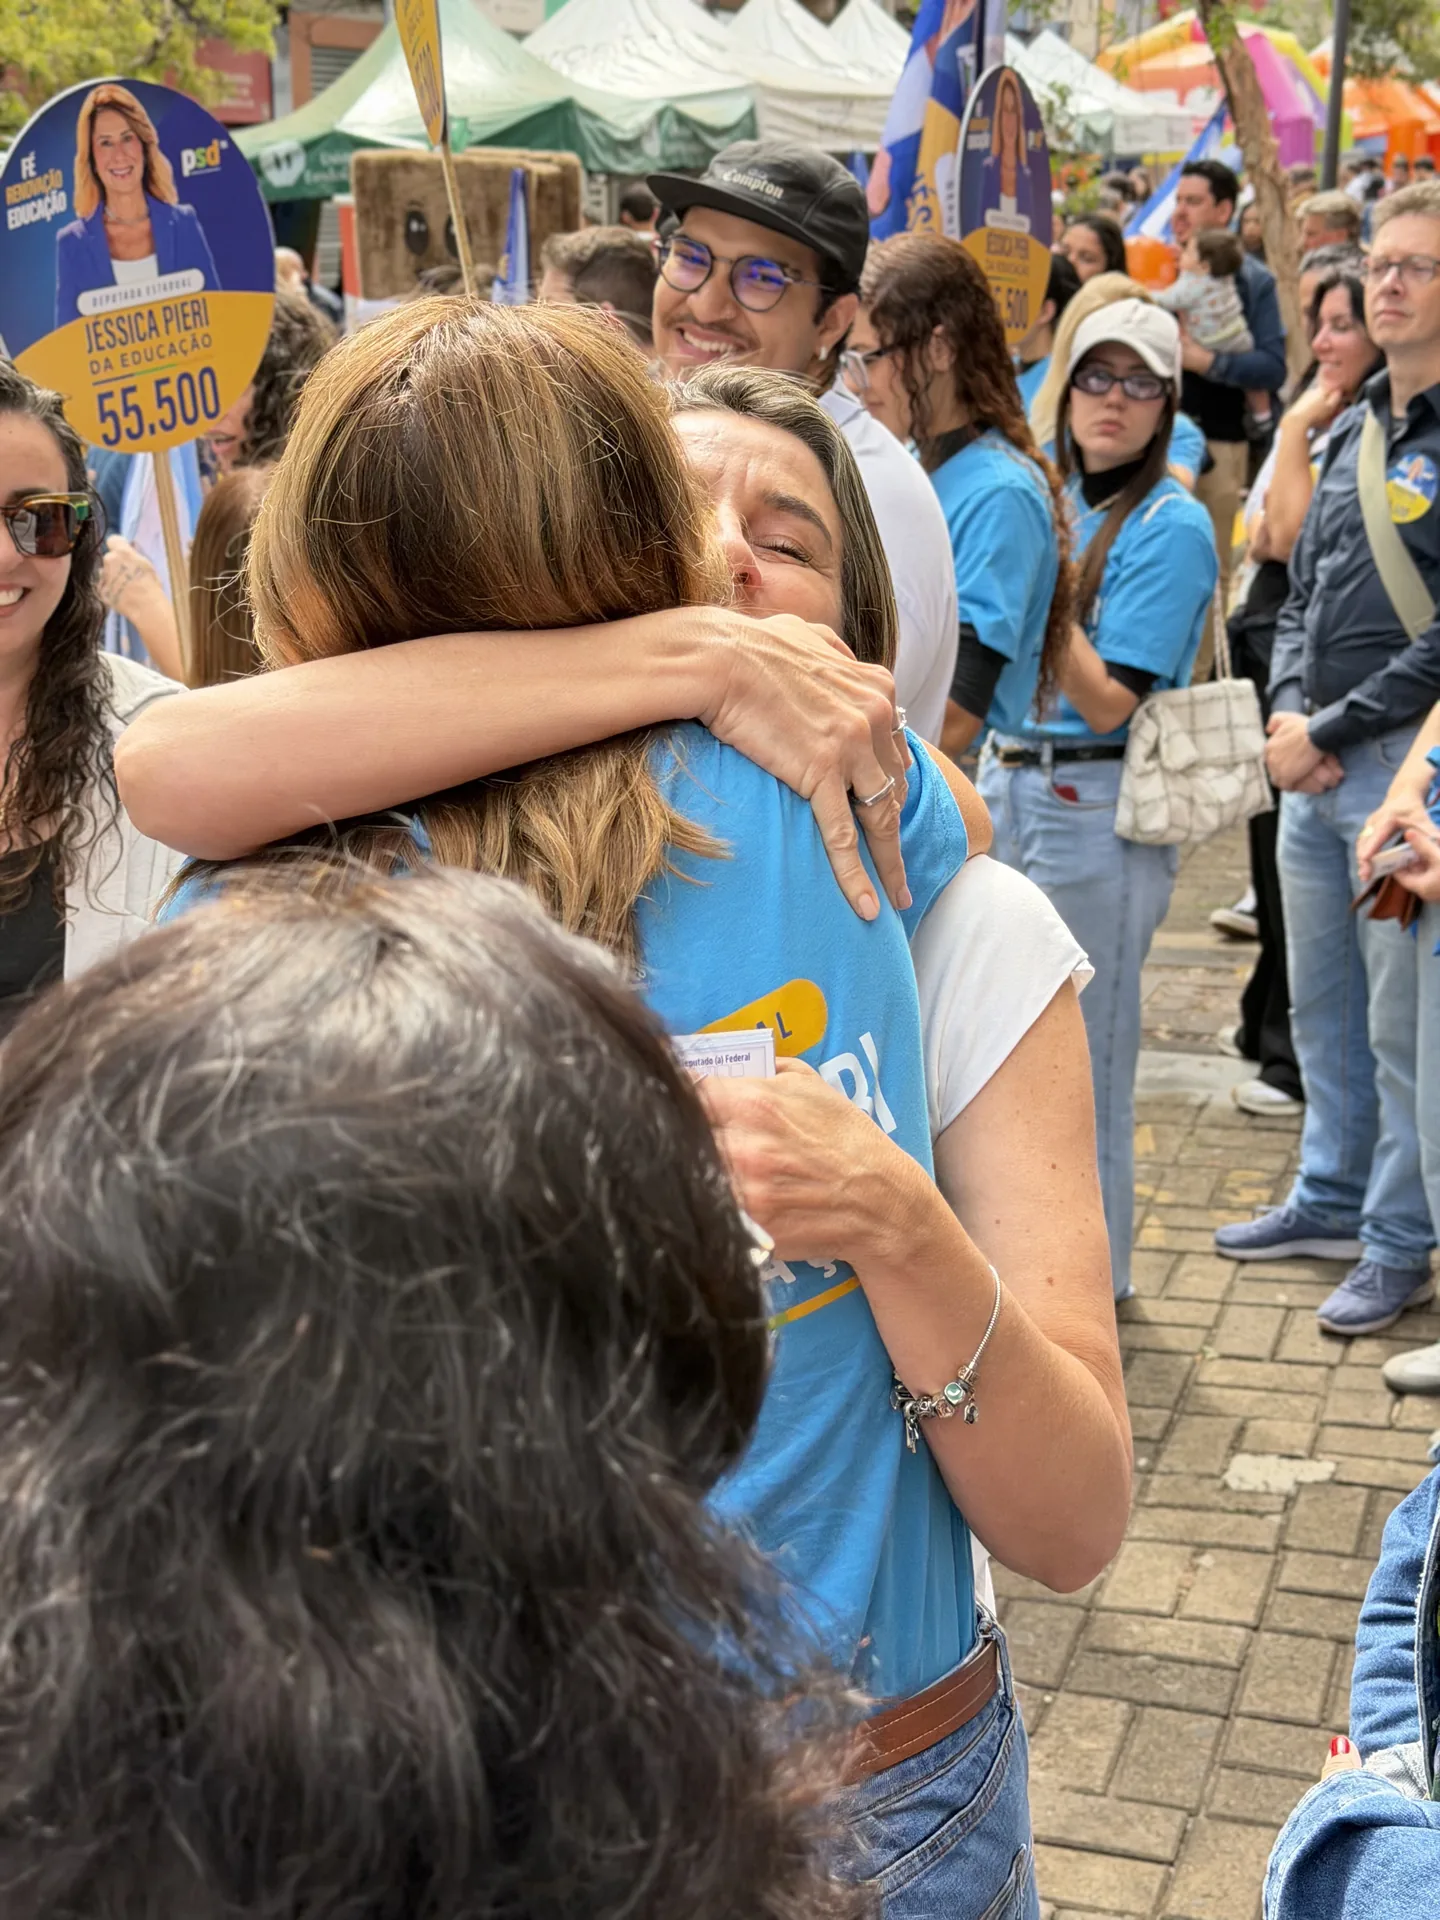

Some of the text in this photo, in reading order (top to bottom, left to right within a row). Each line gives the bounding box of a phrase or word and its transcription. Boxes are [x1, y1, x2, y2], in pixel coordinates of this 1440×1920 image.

[20, 151, 36, 179] FÉ
[181, 138, 220, 178] psd
[723, 168, 784, 199] Compton
[7, 189, 66, 230] EDUCAÇÃO
[162, 298, 209, 335] PIERI
[89, 332, 213, 376] DA EDUCAÇÃO
[97, 366, 219, 446] 55.500
[681, 1052, 751, 1068] eputado (a) Federal
